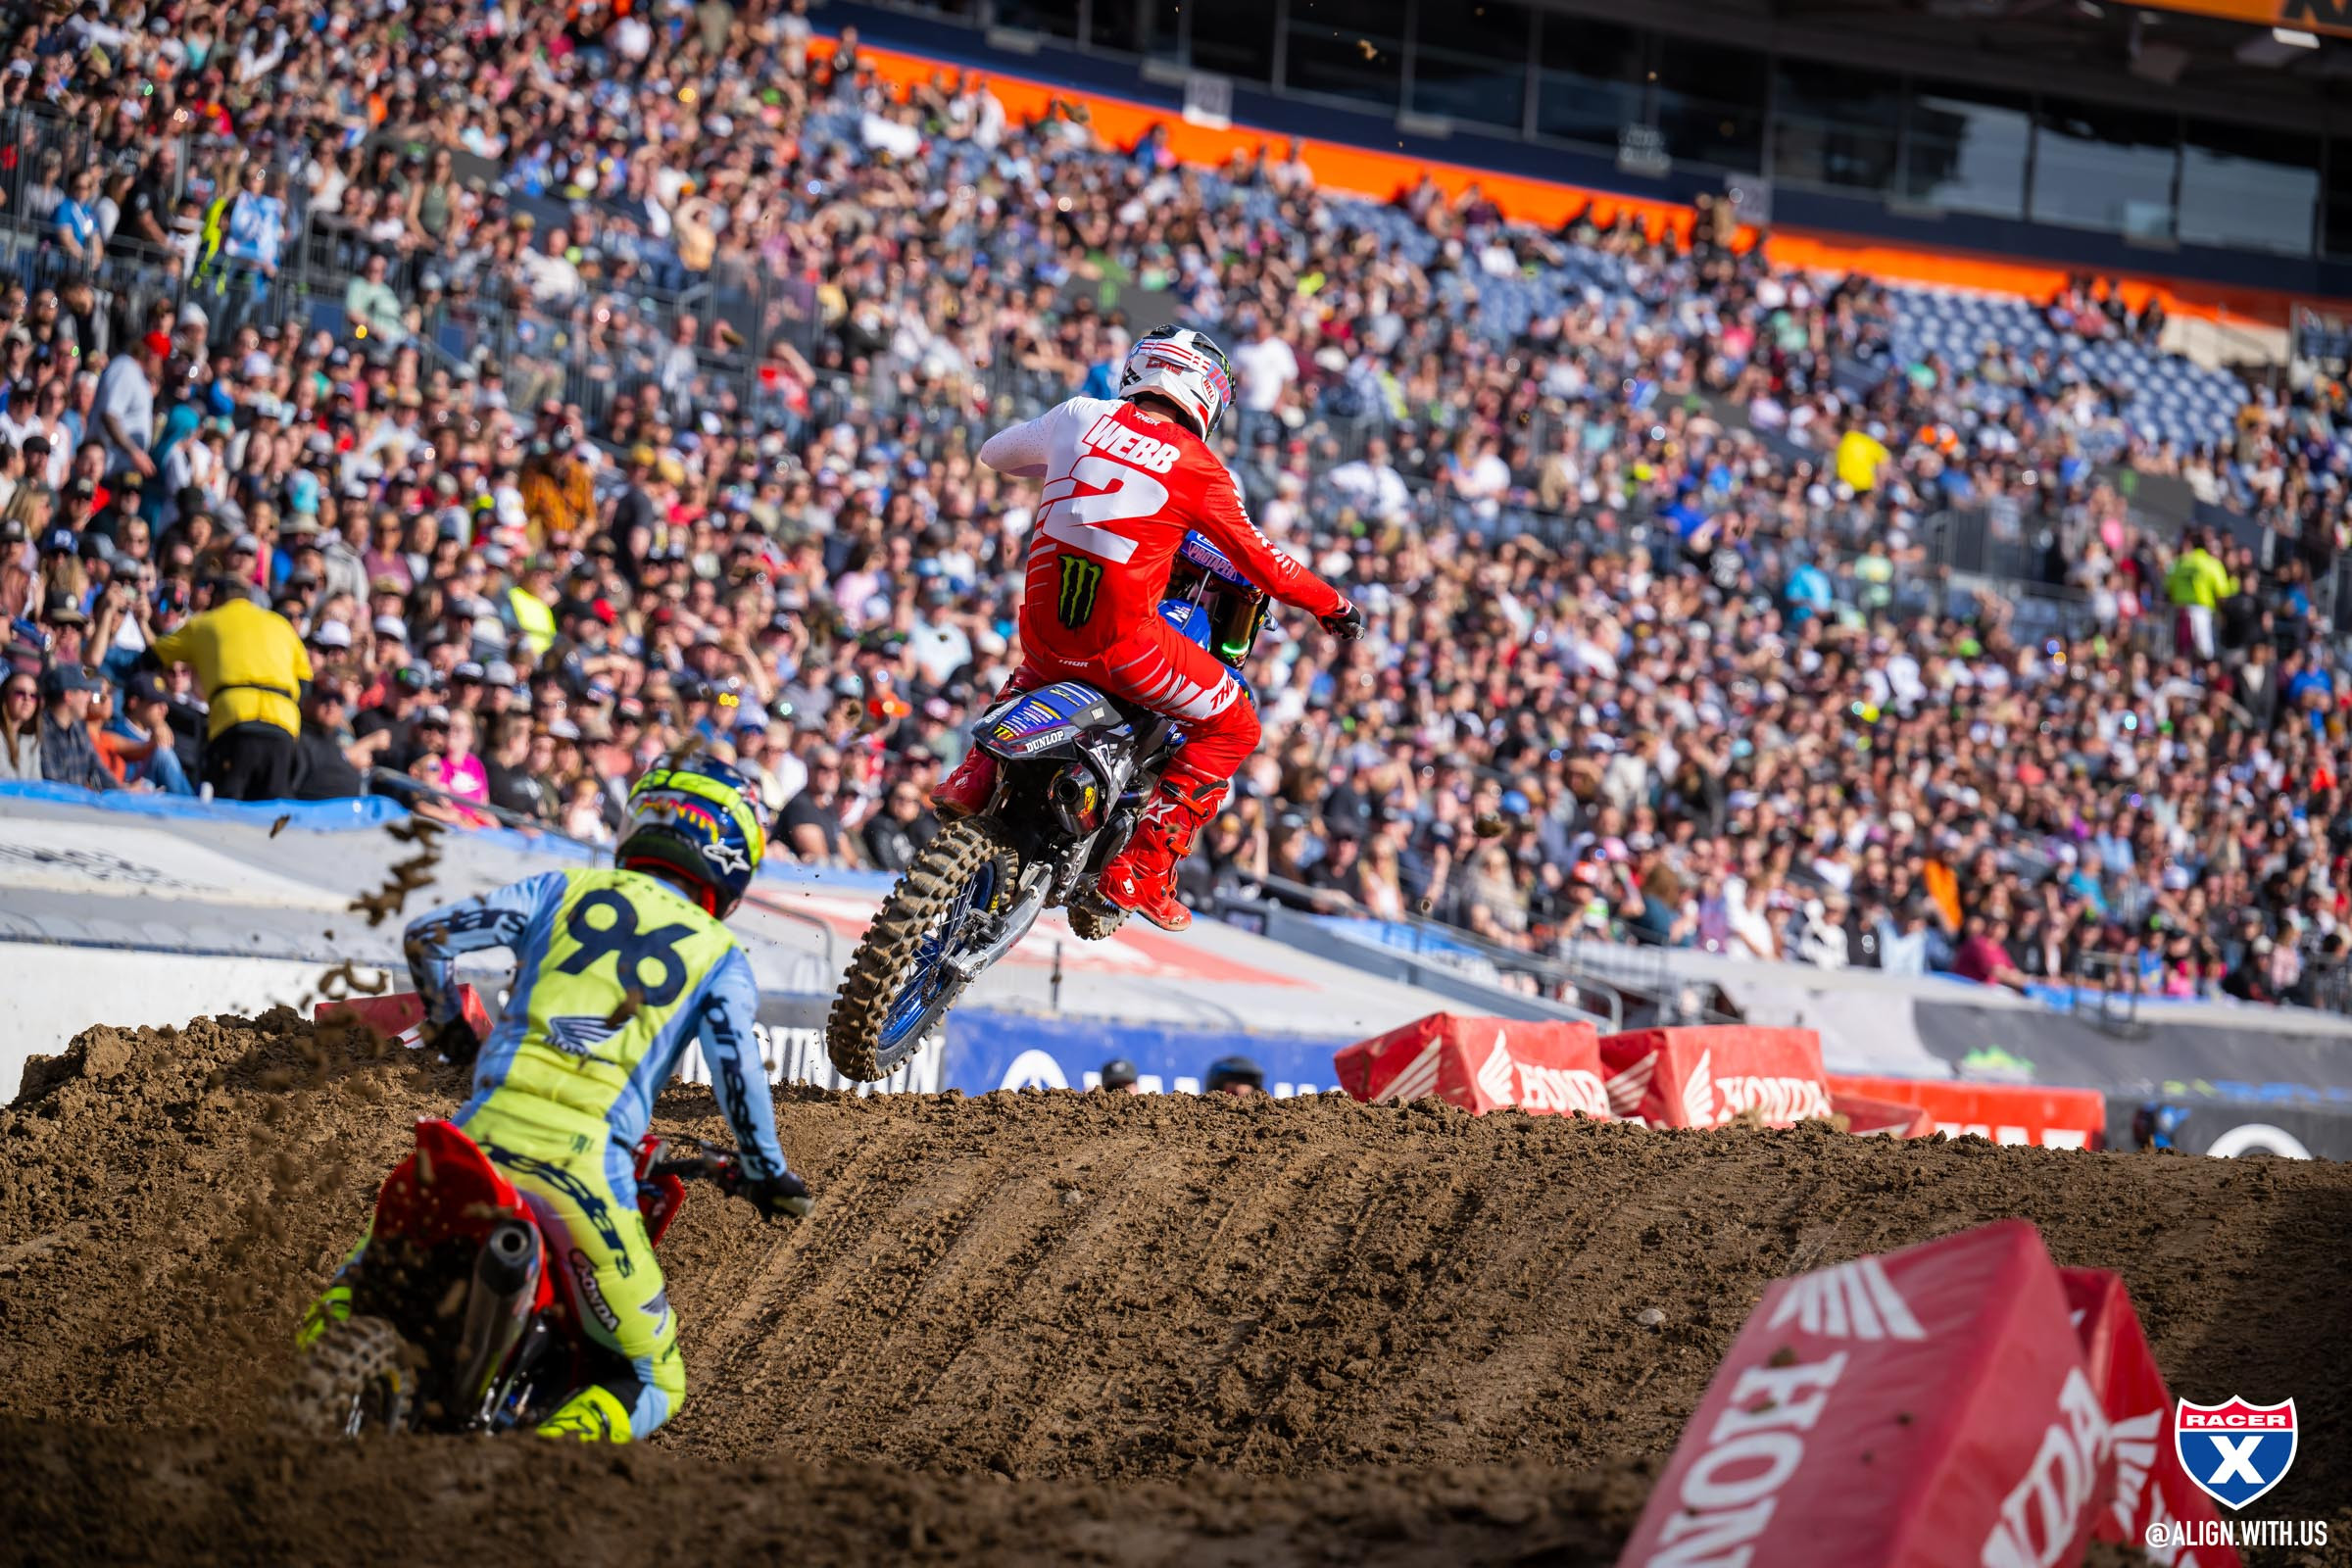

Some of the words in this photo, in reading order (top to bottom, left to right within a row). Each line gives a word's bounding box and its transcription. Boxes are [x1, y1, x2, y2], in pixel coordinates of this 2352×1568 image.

[1202, 379, 1215, 402] BELL
[1082, 415, 1181, 474] WEBB
[1040, 455, 1170, 564] 2
[1025, 730, 1064, 753] DUNLOP
[557, 888, 698, 1007] 96
[1514, 1060, 1610, 1117] HONDA
[1716, 1076, 1833, 1125] HONDA
